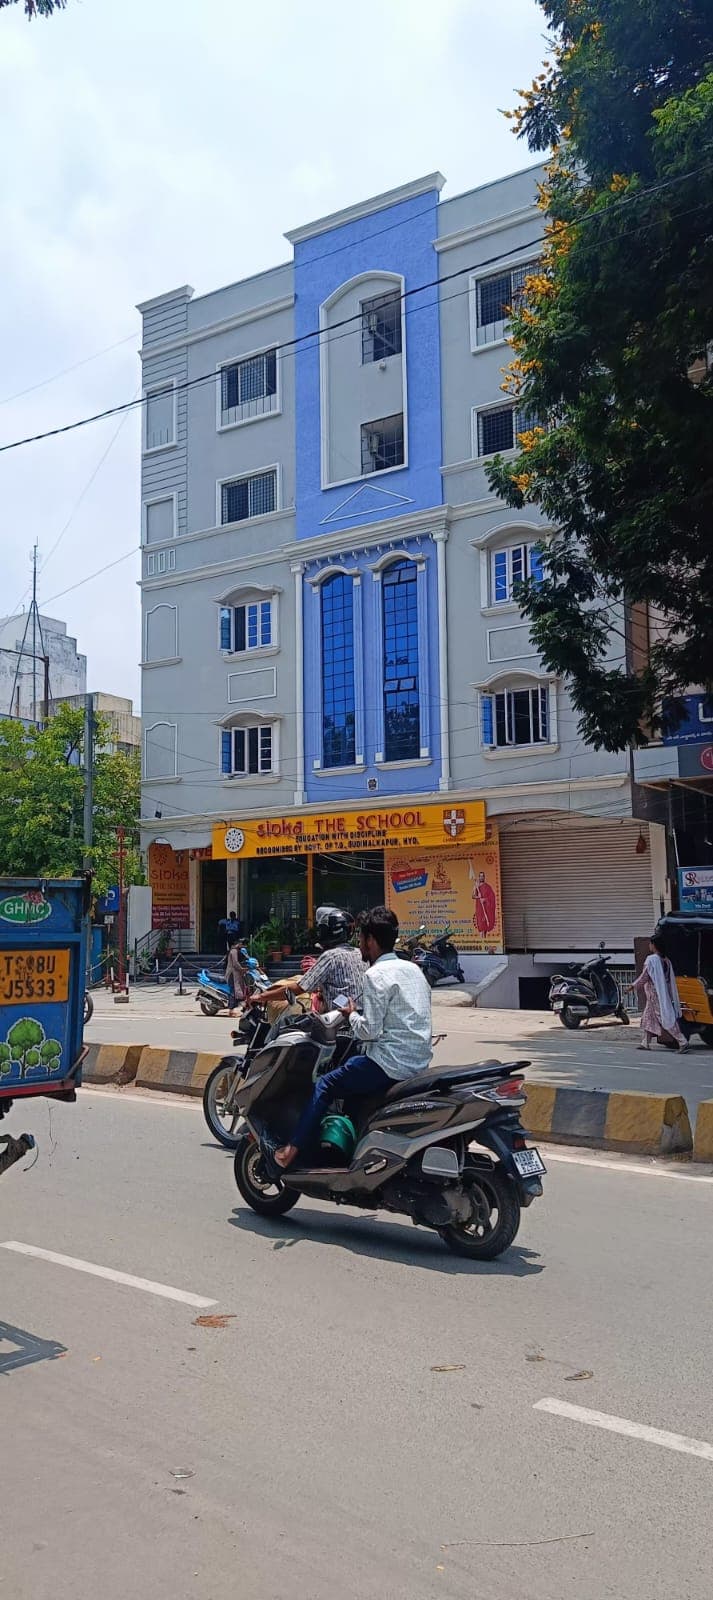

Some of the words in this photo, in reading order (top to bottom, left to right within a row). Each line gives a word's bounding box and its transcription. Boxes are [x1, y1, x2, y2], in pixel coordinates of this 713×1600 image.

[314, 818, 345, 832] THE
[357, 812, 425, 830] SCHOOL
[296, 833, 330, 843] EDUCATION
[332, 832, 348, 840] WITH
[350, 830, 387, 839] DISCIPLINE
[4, 902, 45, 914] GHMC
[4, 979, 56, 999] J5533
